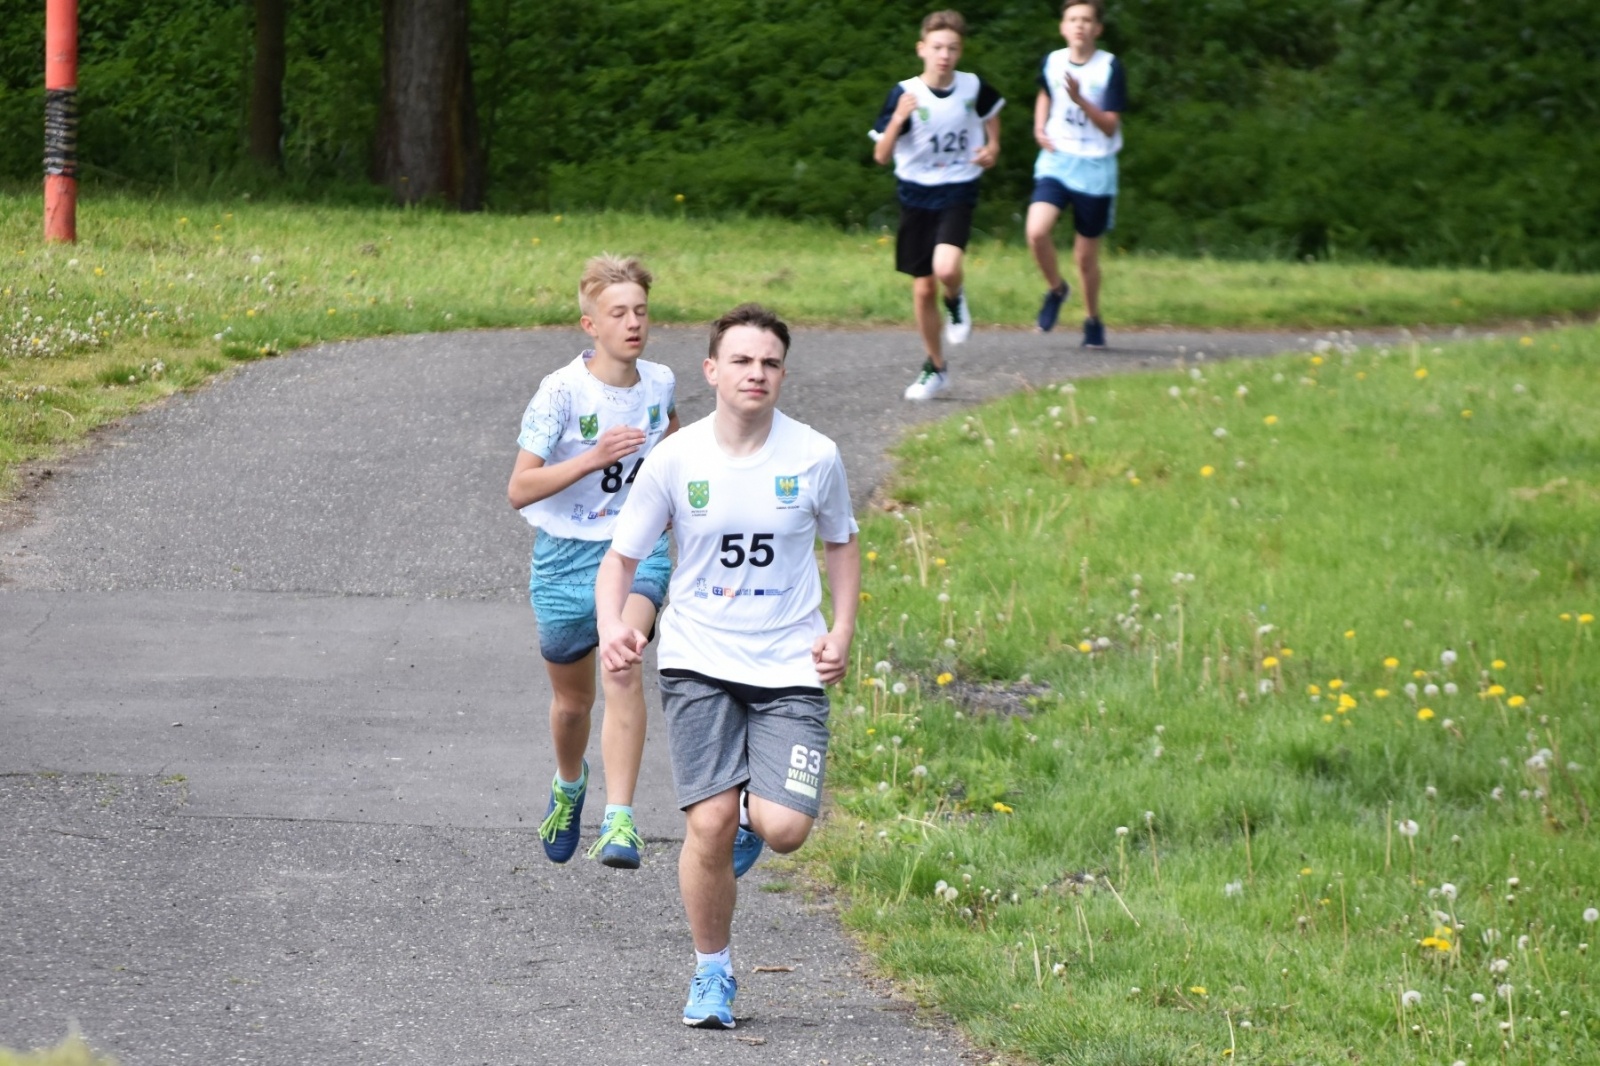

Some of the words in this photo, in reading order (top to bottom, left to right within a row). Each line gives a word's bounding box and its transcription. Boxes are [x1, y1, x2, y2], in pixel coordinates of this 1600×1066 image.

[929, 129, 969, 153] 126
[720, 533, 774, 568] 55
[791, 744, 821, 775] 63
[788, 767, 819, 787] WHITE
